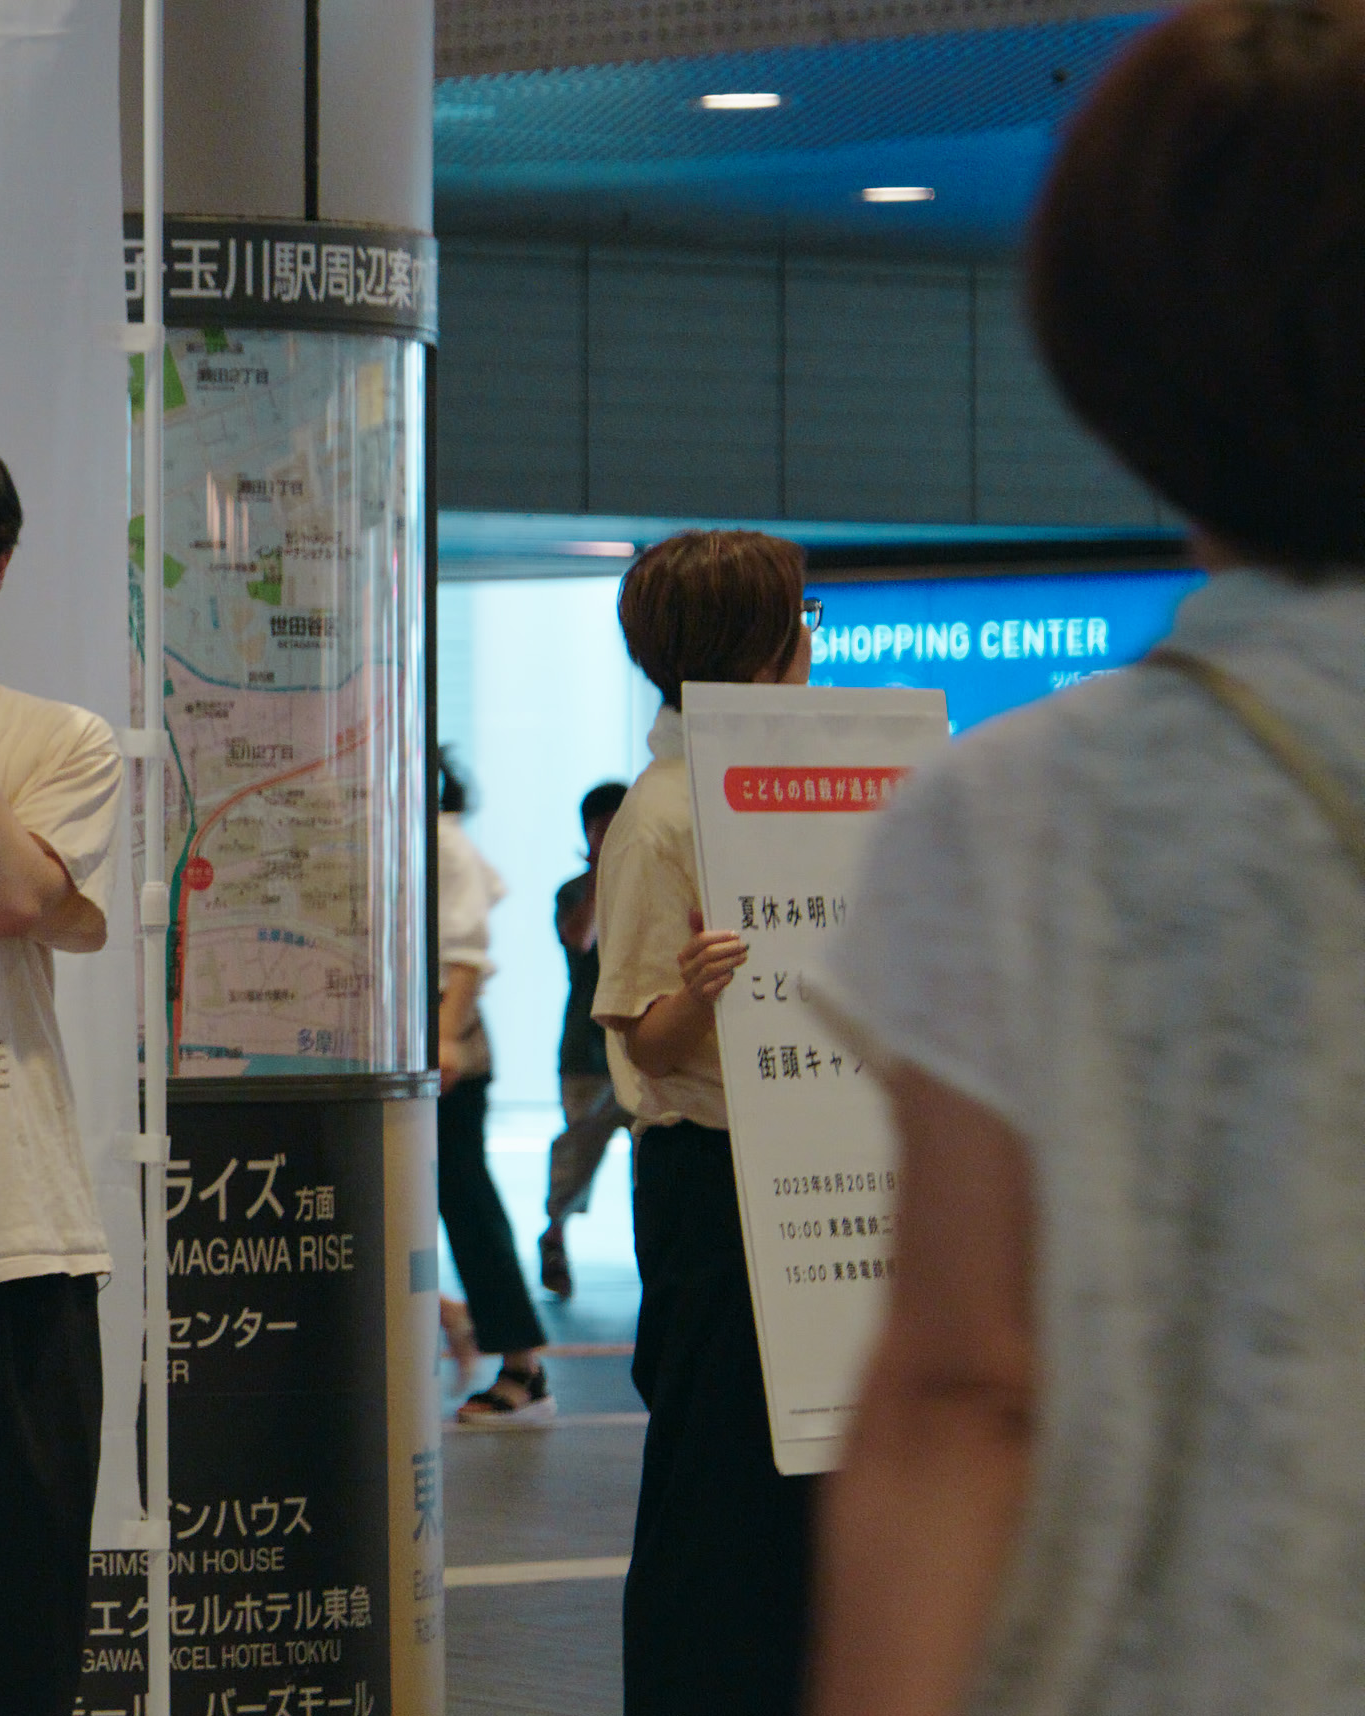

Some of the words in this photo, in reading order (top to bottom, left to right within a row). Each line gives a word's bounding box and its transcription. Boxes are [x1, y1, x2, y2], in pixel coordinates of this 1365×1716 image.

[810, 622, 969, 665] SHOPPING
[980, 616, 1109, 661] CENTER
[165, 1152, 287, 1222] ライズ
[295, 1185, 336, 1223] 方面
[779, 1219, 822, 1241] 10:00
[299, 1233, 355, 1274] RISE
[785, 1262, 828, 1285] 15:00
[832, 1258, 899, 1283] 東急電鉄
[167, 1306, 298, 1350] センター
[168, 1495, 313, 1541] ンハウス
[203, 1546, 286, 1574] HOUSE
[88, 1585, 373, 1639] エクセルホテル東急
[81, 1647, 145, 1674] GAWA
[221, 1641, 282, 1669] HOTEL
[284, 1638, 343, 1665] TOKYU
